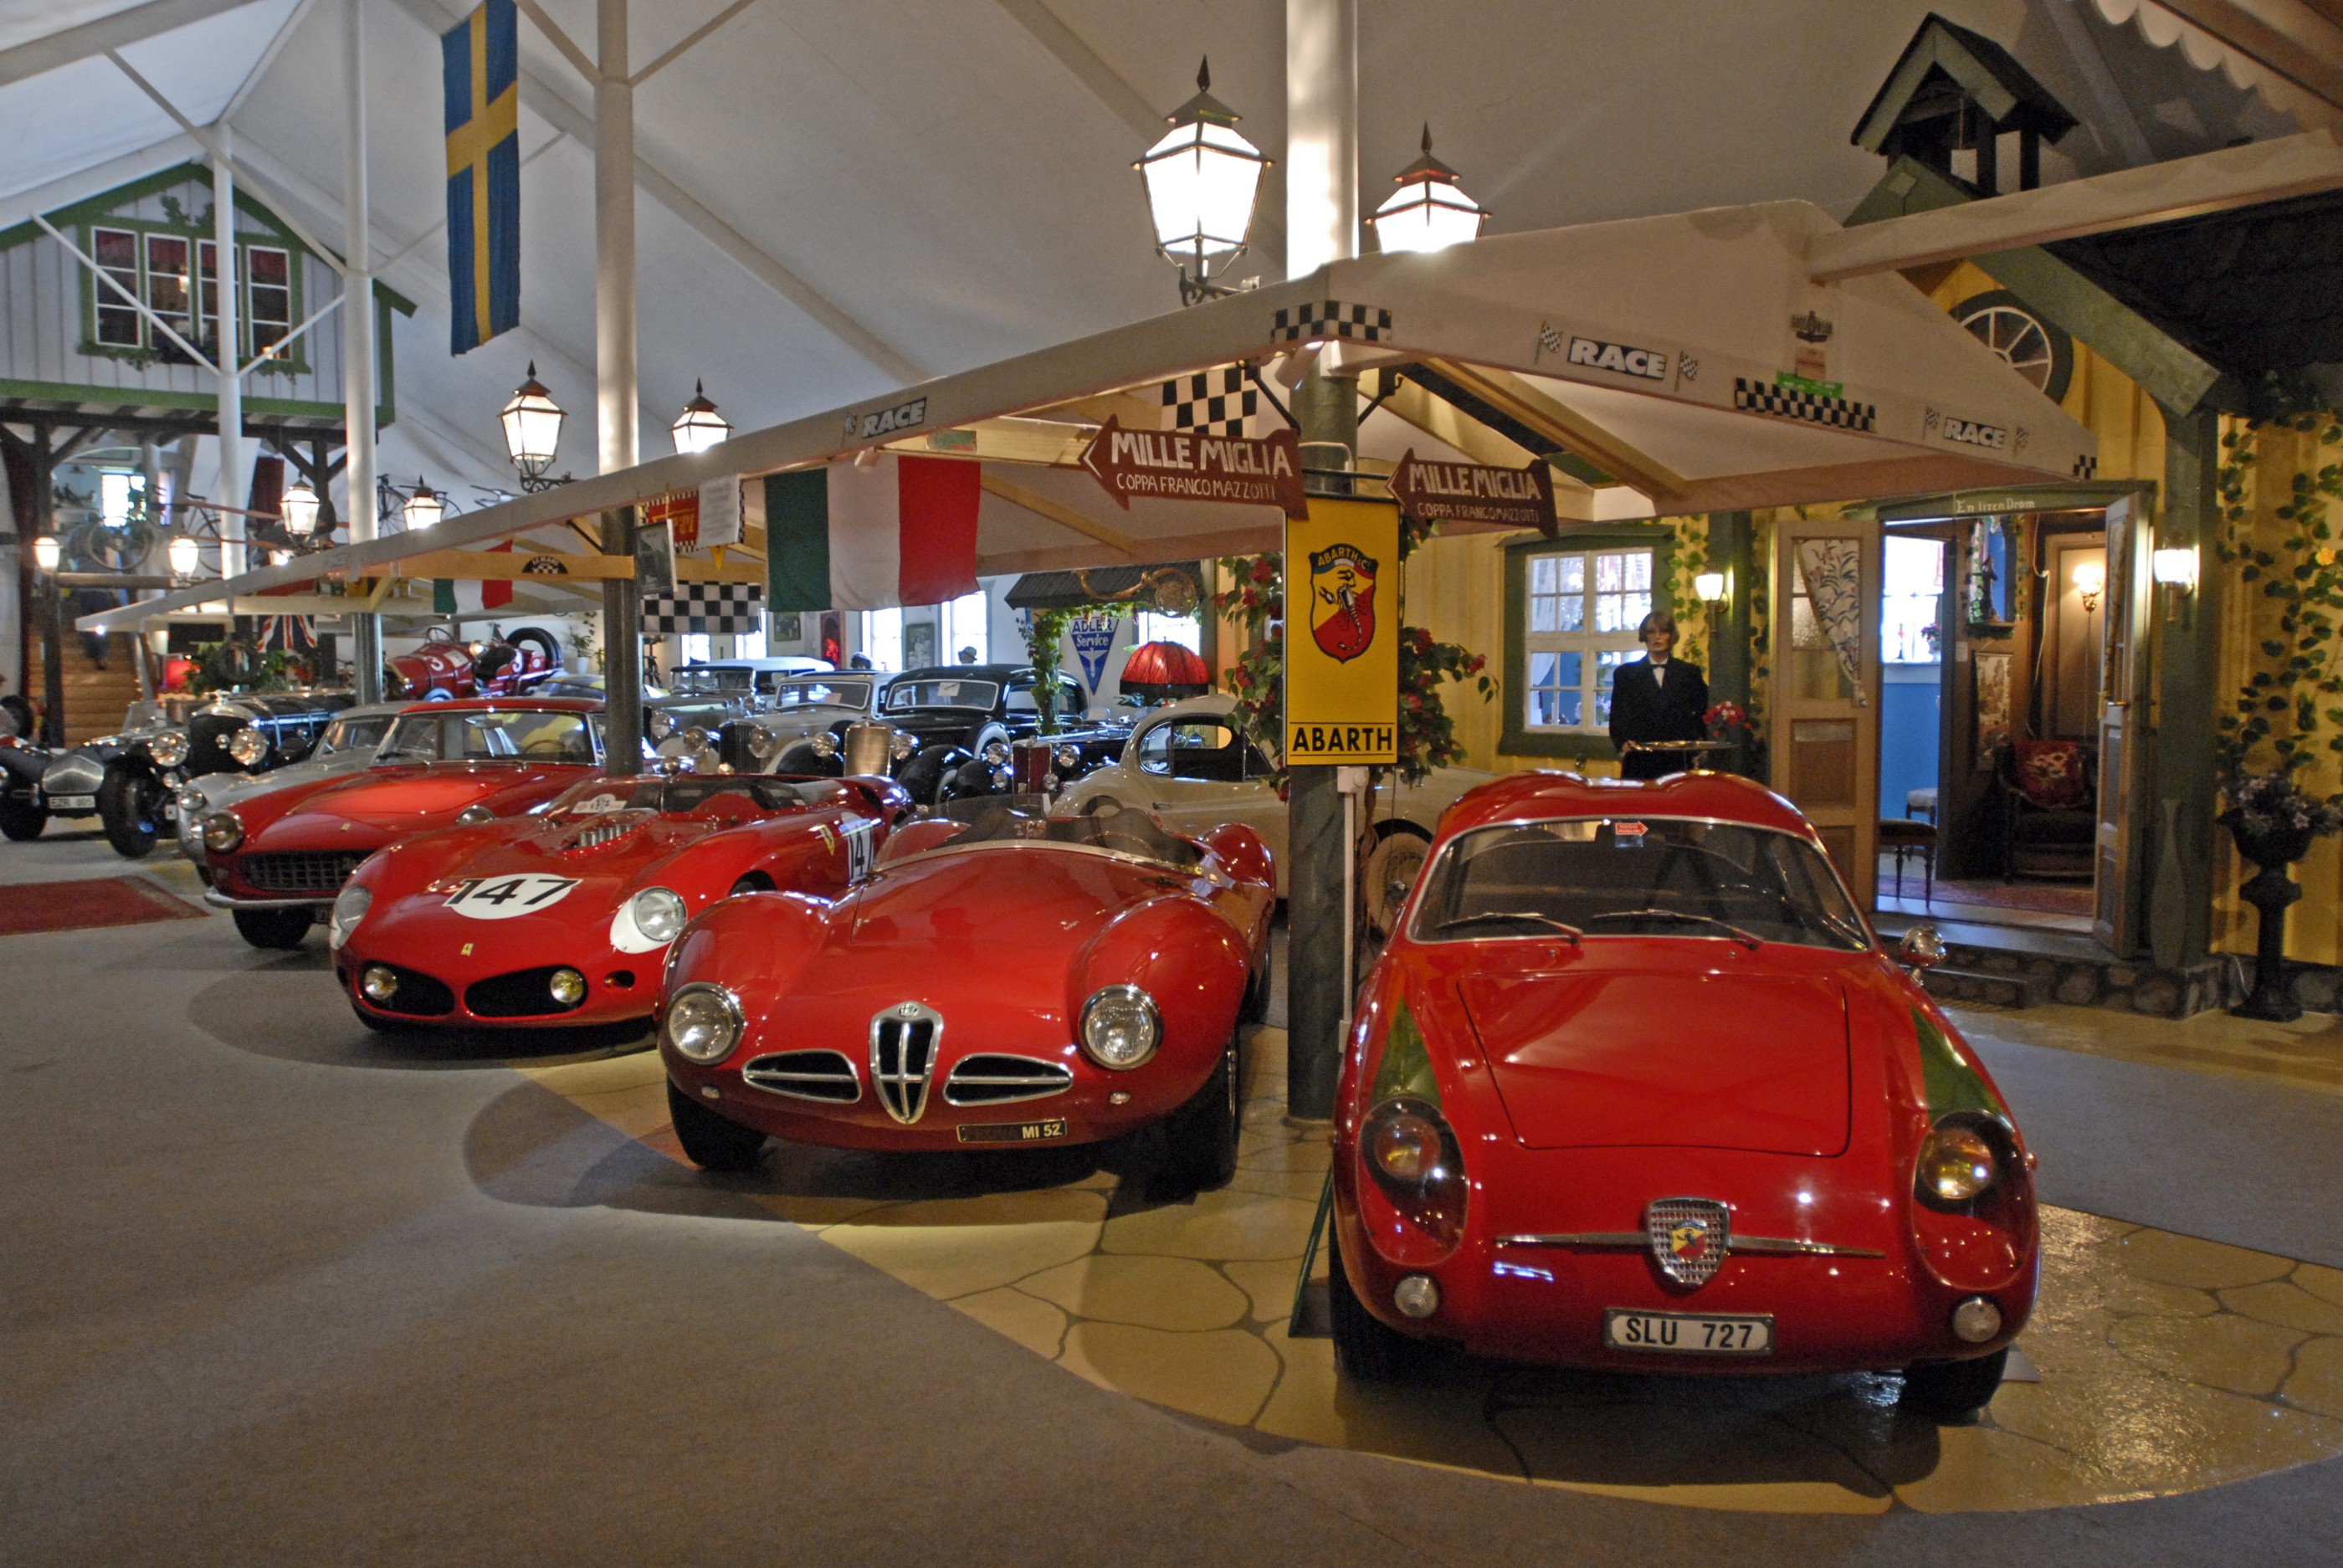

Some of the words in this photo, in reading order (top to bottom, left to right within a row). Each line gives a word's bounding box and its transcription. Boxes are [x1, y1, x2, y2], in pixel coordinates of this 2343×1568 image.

[1570, 337, 1667, 379] RACE
[862, 400, 925, 438] RACE
[1944, 418, 2005, 449] RACE
[1111, 432, 1194, 469] MILLE
[1200, 439, 1294, 477] MIGLIA
[1116, 473, 1158, 492] COPPA
[1160, 476, 1211, 495] FRANCO
[1213, 482, 1275, 500] MAZZOTTI
[1410, 464, 1469, 495] MILLE
[1473, 469, 1542, 500] MIGLIA
[1418, 503, 1454, 517] COPPA
[1456, 505, 1495, 520] FRANCO
[1318, 547, 1358, 566] ABARTH
[1072, 619, 1113, 633] ADLER
[1076, 633, 1109, 647] Service
[1292, 727, 1392, 751] ABARTH
[447, 879, 580, 905] 147
[1022, 1126, 1039, 1139] MI
[1043, 1124, 1061, 1137] 52
[1626, 1318, 1678, 1345] SLU
[1702, 1323, 1753, 1349] 727
